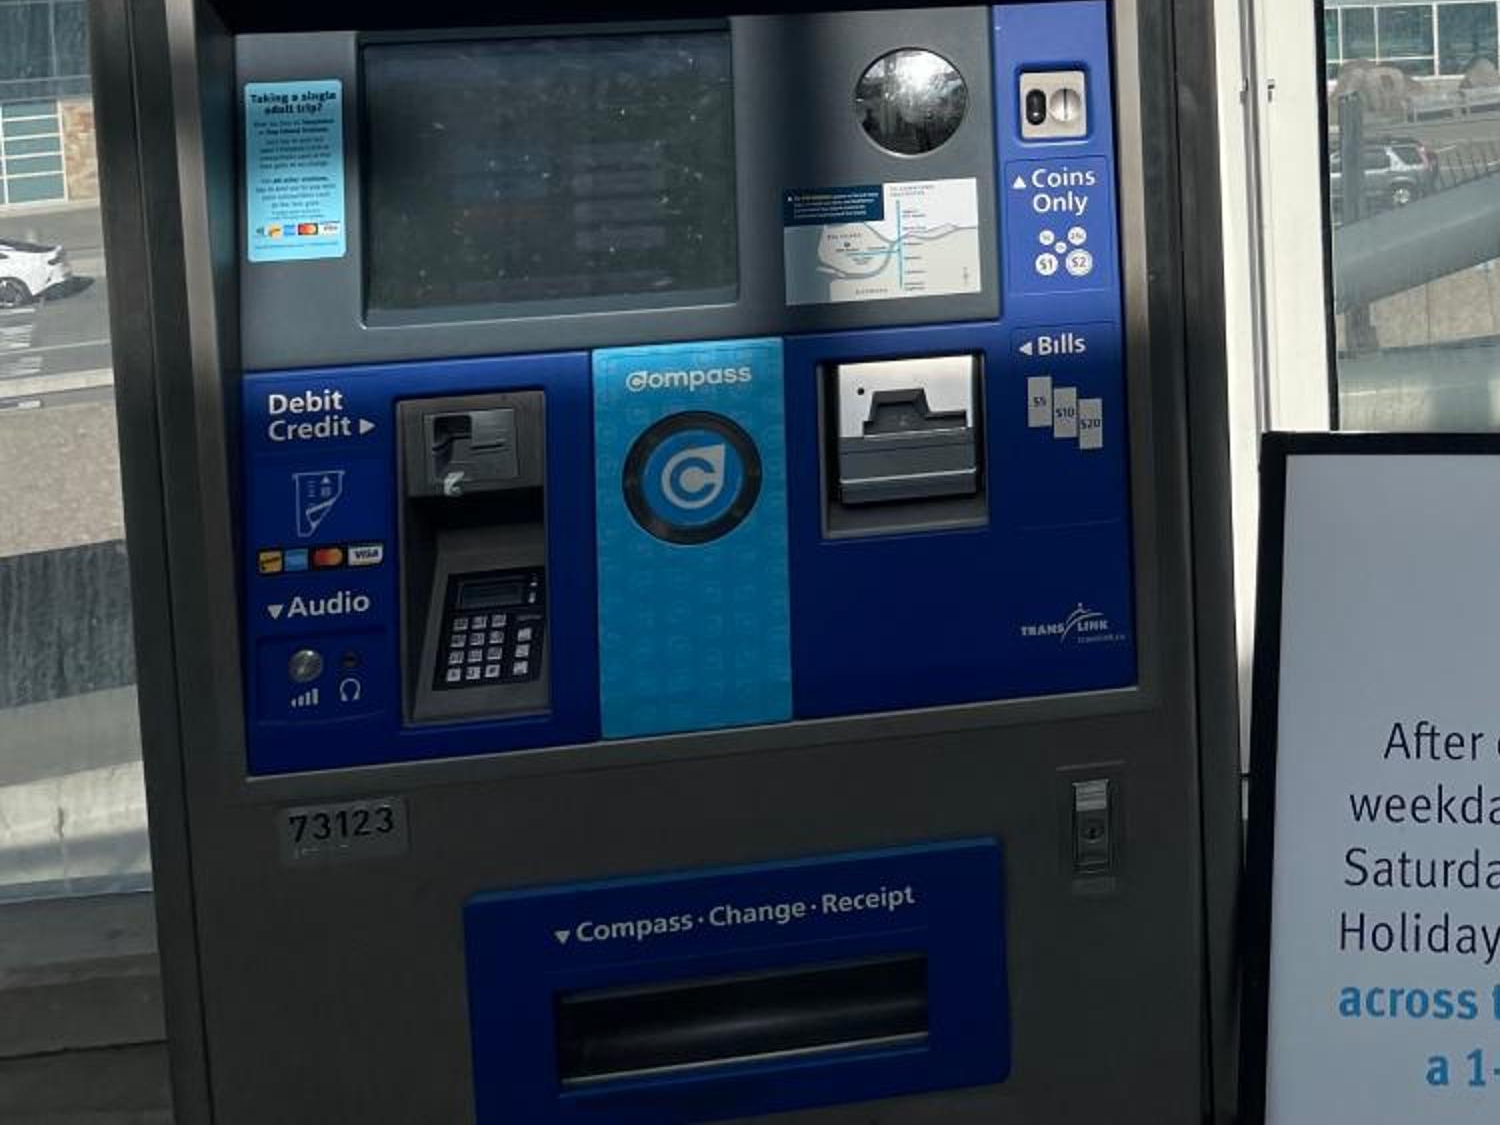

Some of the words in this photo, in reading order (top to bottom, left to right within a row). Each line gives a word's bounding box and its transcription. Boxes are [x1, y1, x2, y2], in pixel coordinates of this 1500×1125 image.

[251, 92, 289, 104] Taking
[1032, 166, 1096, 188] Coins
[1033, 191, 1088, 216] Only
[1037, 332, 1087, 355] Bills
[268, 390, 343, 414] Debit
[268, 417, 352, 442] Credit
[287, 592, 370, 618] Audio
[1383, 722, 1483, 761] After
[289, 807, 394, 843] 73123
[576, 913, 693, 944] Compass
[708, 900, 806, 930] Change
[821, 884, 915, 914] Receipt
[1339, 985, 1478, 1020] across
[1426, 1056, 1449, 1087] a
